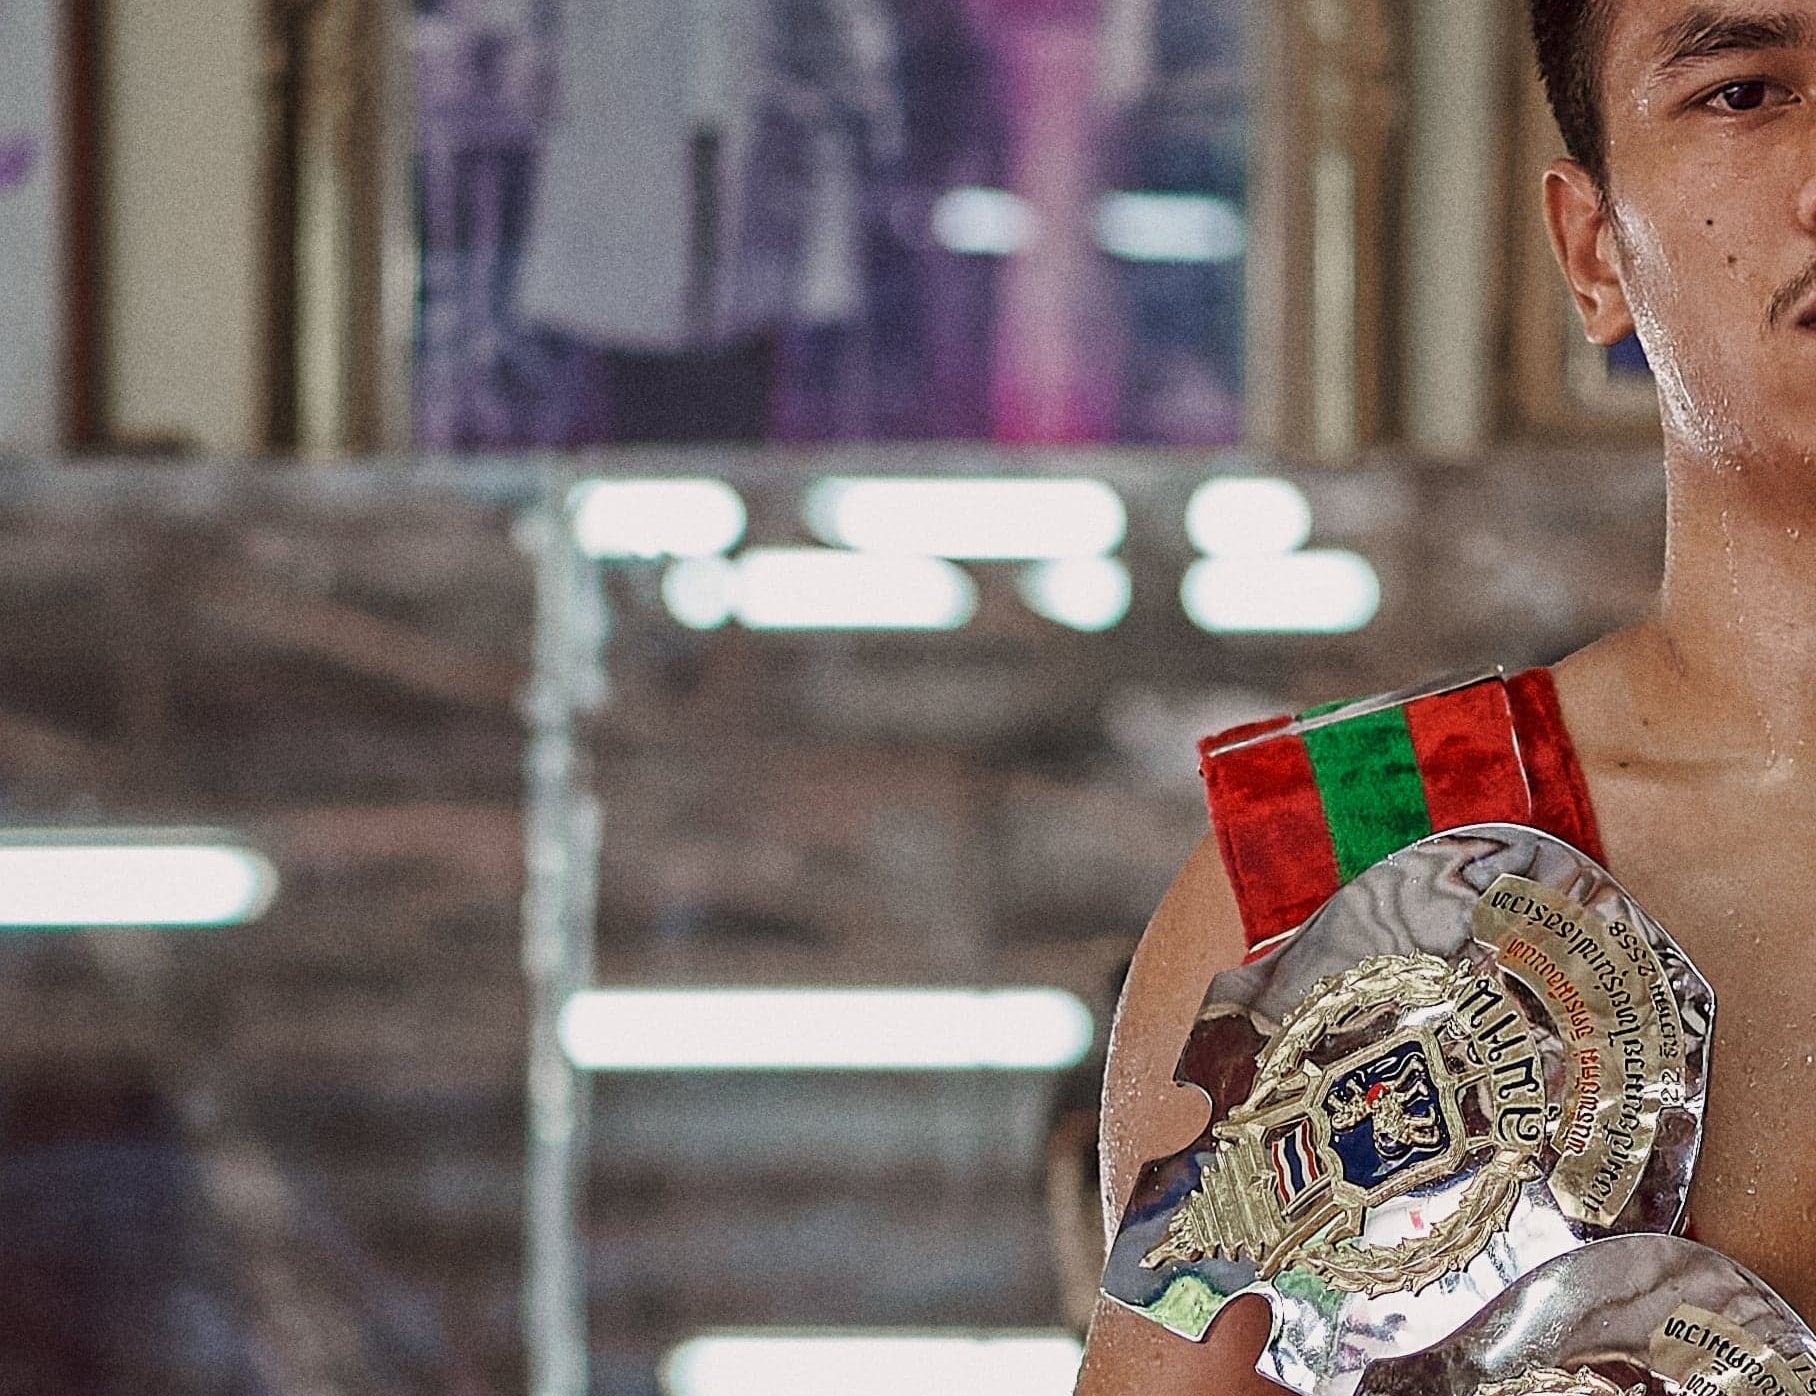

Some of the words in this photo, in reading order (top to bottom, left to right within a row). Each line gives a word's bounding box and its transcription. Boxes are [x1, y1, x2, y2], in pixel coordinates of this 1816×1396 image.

[1609, 921, 1656, 977] 2558
[1502, 937, 1594, 1041] จิตรเมืองนนท์
[1650, 984, 1680, 1059] ธันวาคม
[1448, 980, 1561, 1141] ลุมพินี
[1660, 1069, 1681, 1101] 22
